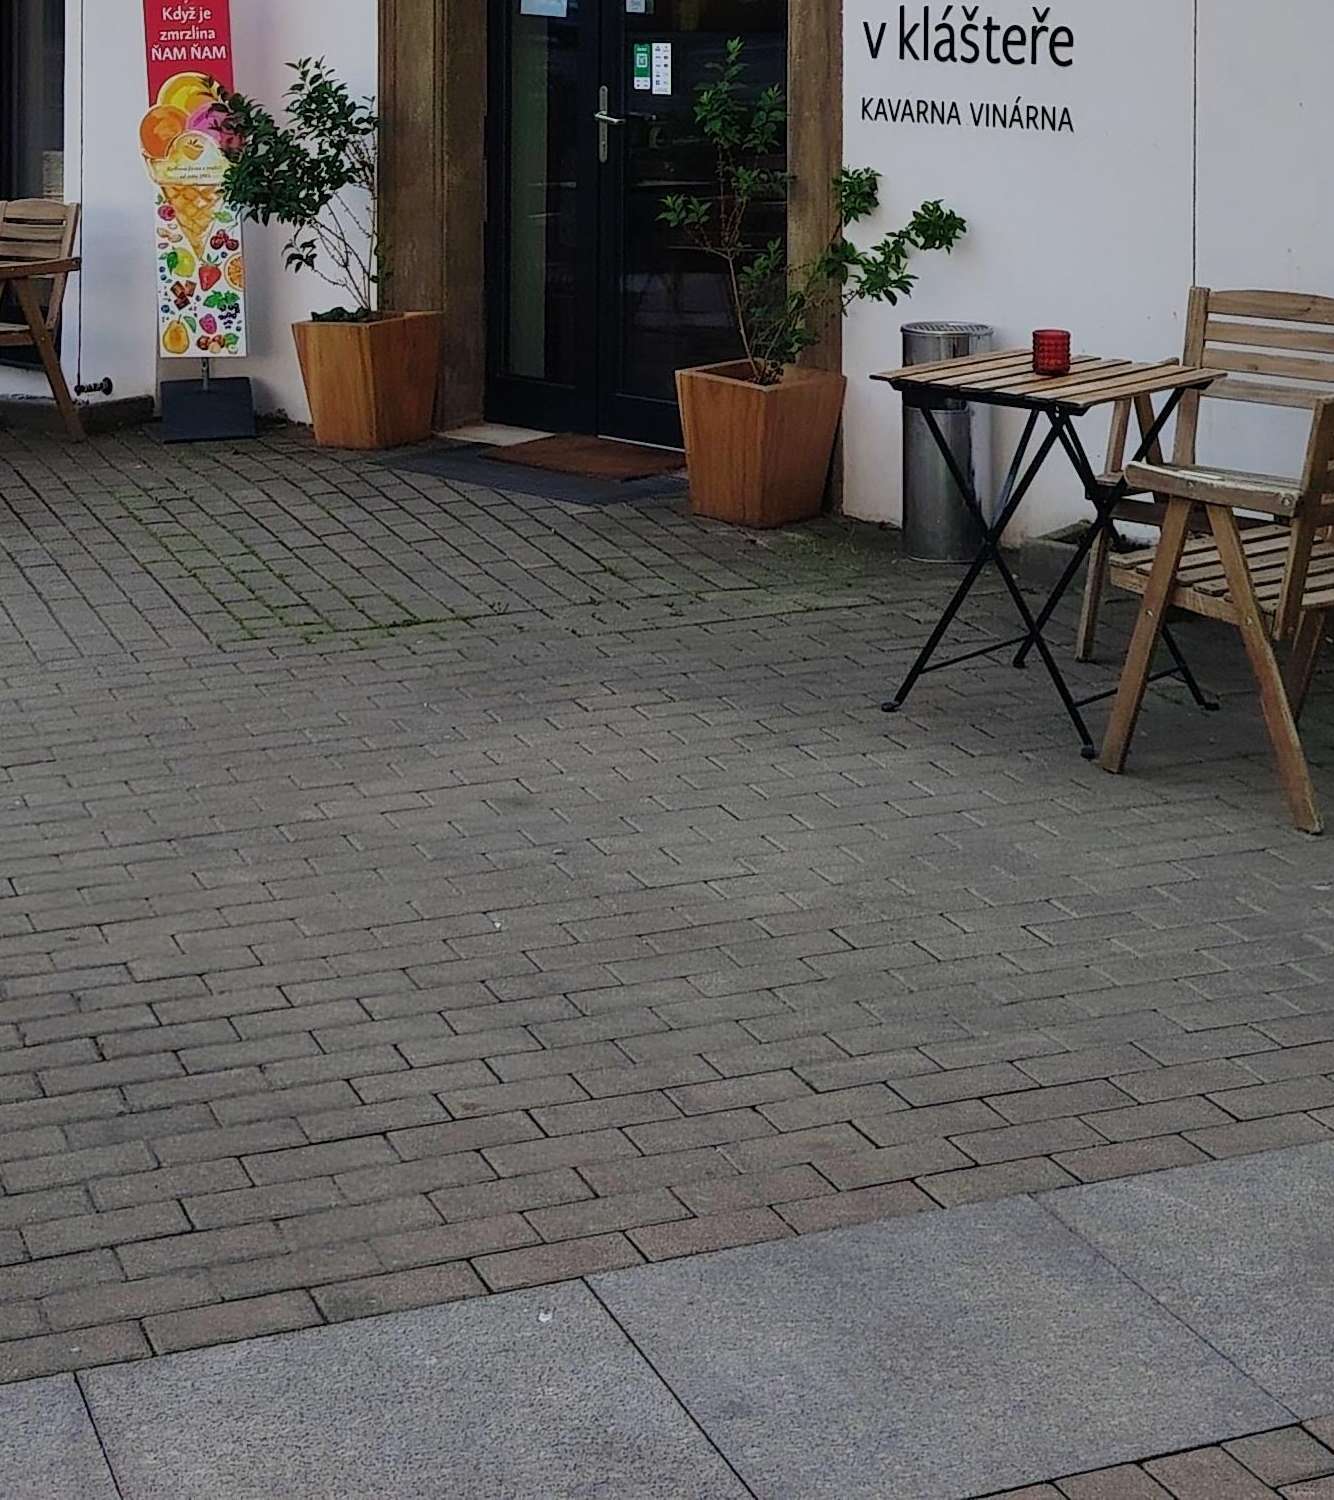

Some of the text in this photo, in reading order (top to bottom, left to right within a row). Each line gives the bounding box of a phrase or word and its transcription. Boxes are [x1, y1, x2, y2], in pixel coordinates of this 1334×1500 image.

[162, 5, 212, 24] Když je
[159, 25, 216, 41] zmrzlina
[862, 4, 1074, 67] v klášteře
[151, 43, 227, 61] ŇAM ŇAM
[861, 96, 1075, 133] KAVARNA VINÁRNA
